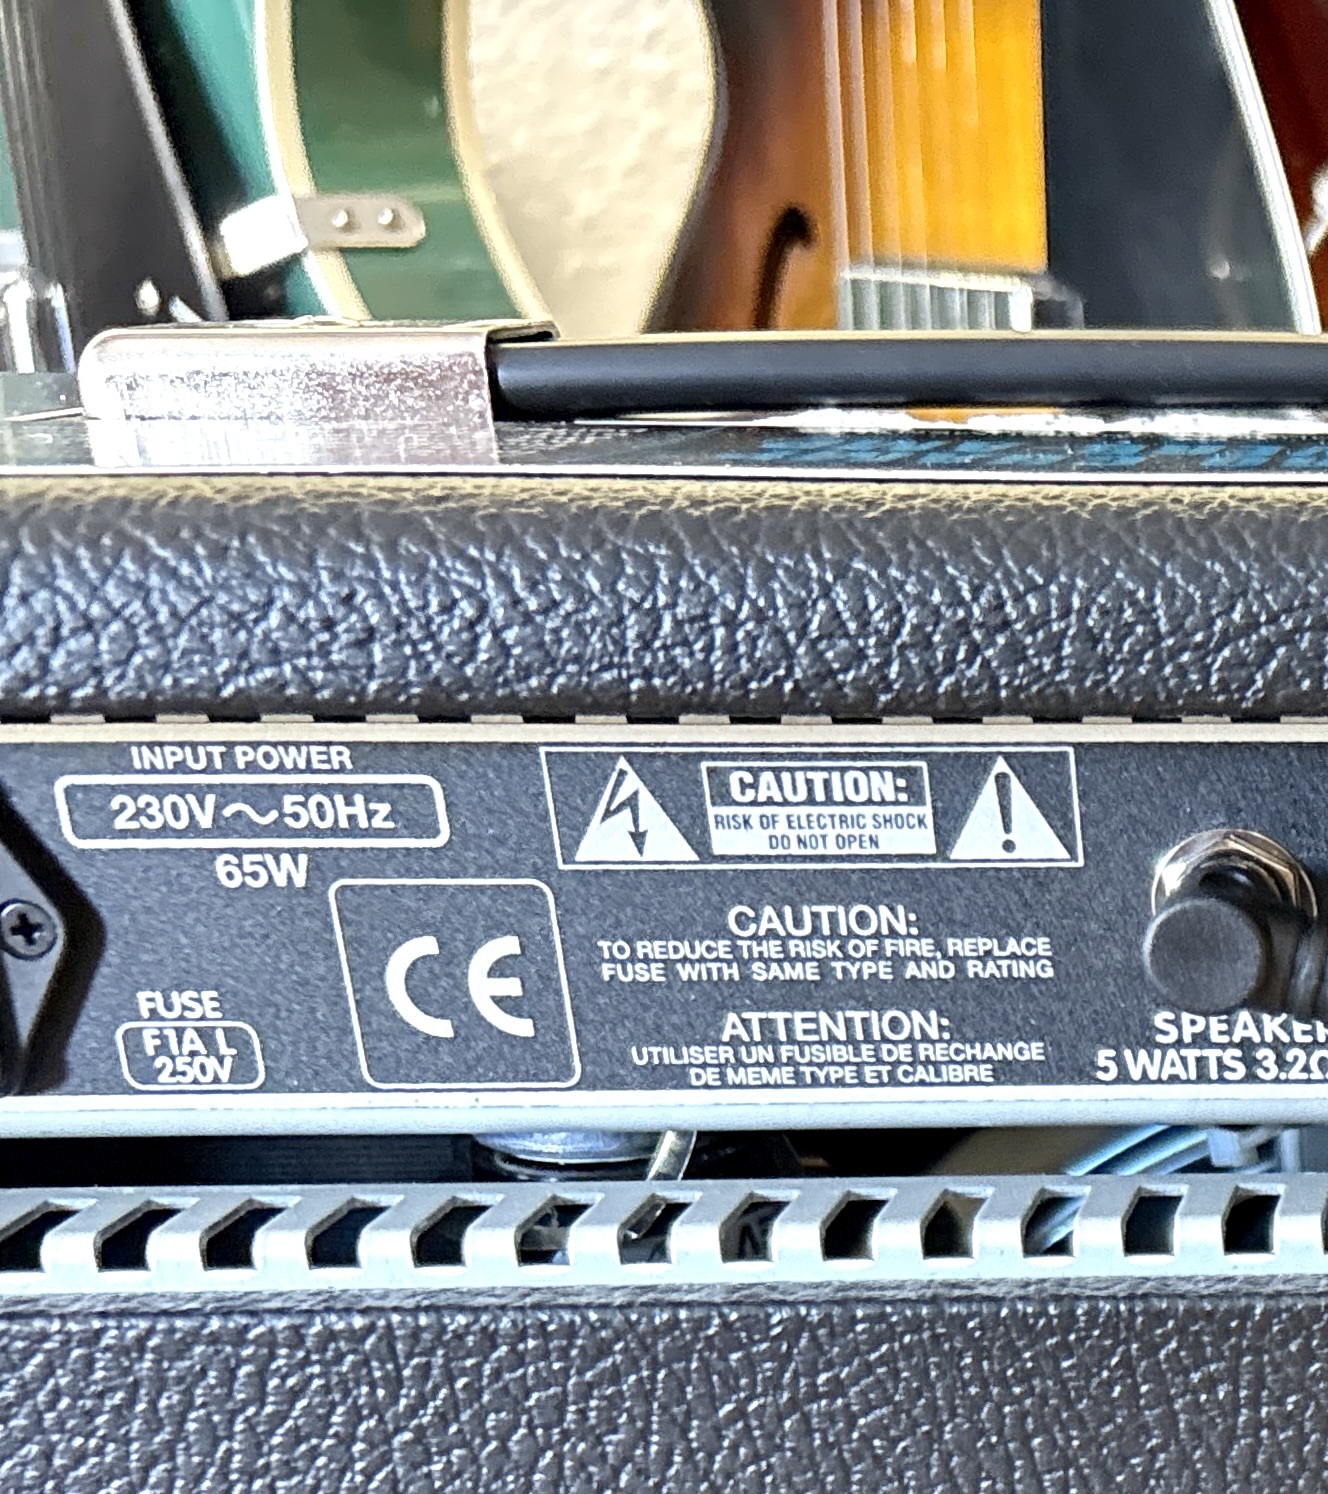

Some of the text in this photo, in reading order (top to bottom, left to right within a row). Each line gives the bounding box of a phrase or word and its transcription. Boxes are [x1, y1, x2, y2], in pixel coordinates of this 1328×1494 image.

[132, 745, 353, 771] INPUT POWER
[729, 770, 908, 803] CAUTION:
[715, 813, 928, 831] RISK OF ELECTRIC SHOCK
[769, 834, 880, 851] DO NOT OPEN
[216, 854, 308, 888] 65W
[727, 904, 918, 937] CAUTION:
[598, 937, 1051, 960] TO REDUCE THE RISK OF FIRE, REPLACE
[601, 960, 1054, 982] FUSE WITH SAME TYPE AND RATING
[384, 935, 534, 1038] CE
[137, 991, 222, 1019] FUSE
[721, 1010, 951, 1042] ATTENTION:
[632, 1043, 1045, 1065] UTILISER UN FUSIBLE DE RECHANGE
[1096, 1049, 1118, 1081] 5
[1125, 1049, 1245, 1081] WATTS
[154, 1056, 233, 1083] 250V
[690, 1064, 994, 1086] DE MEME TYPE ET CALIBRE
